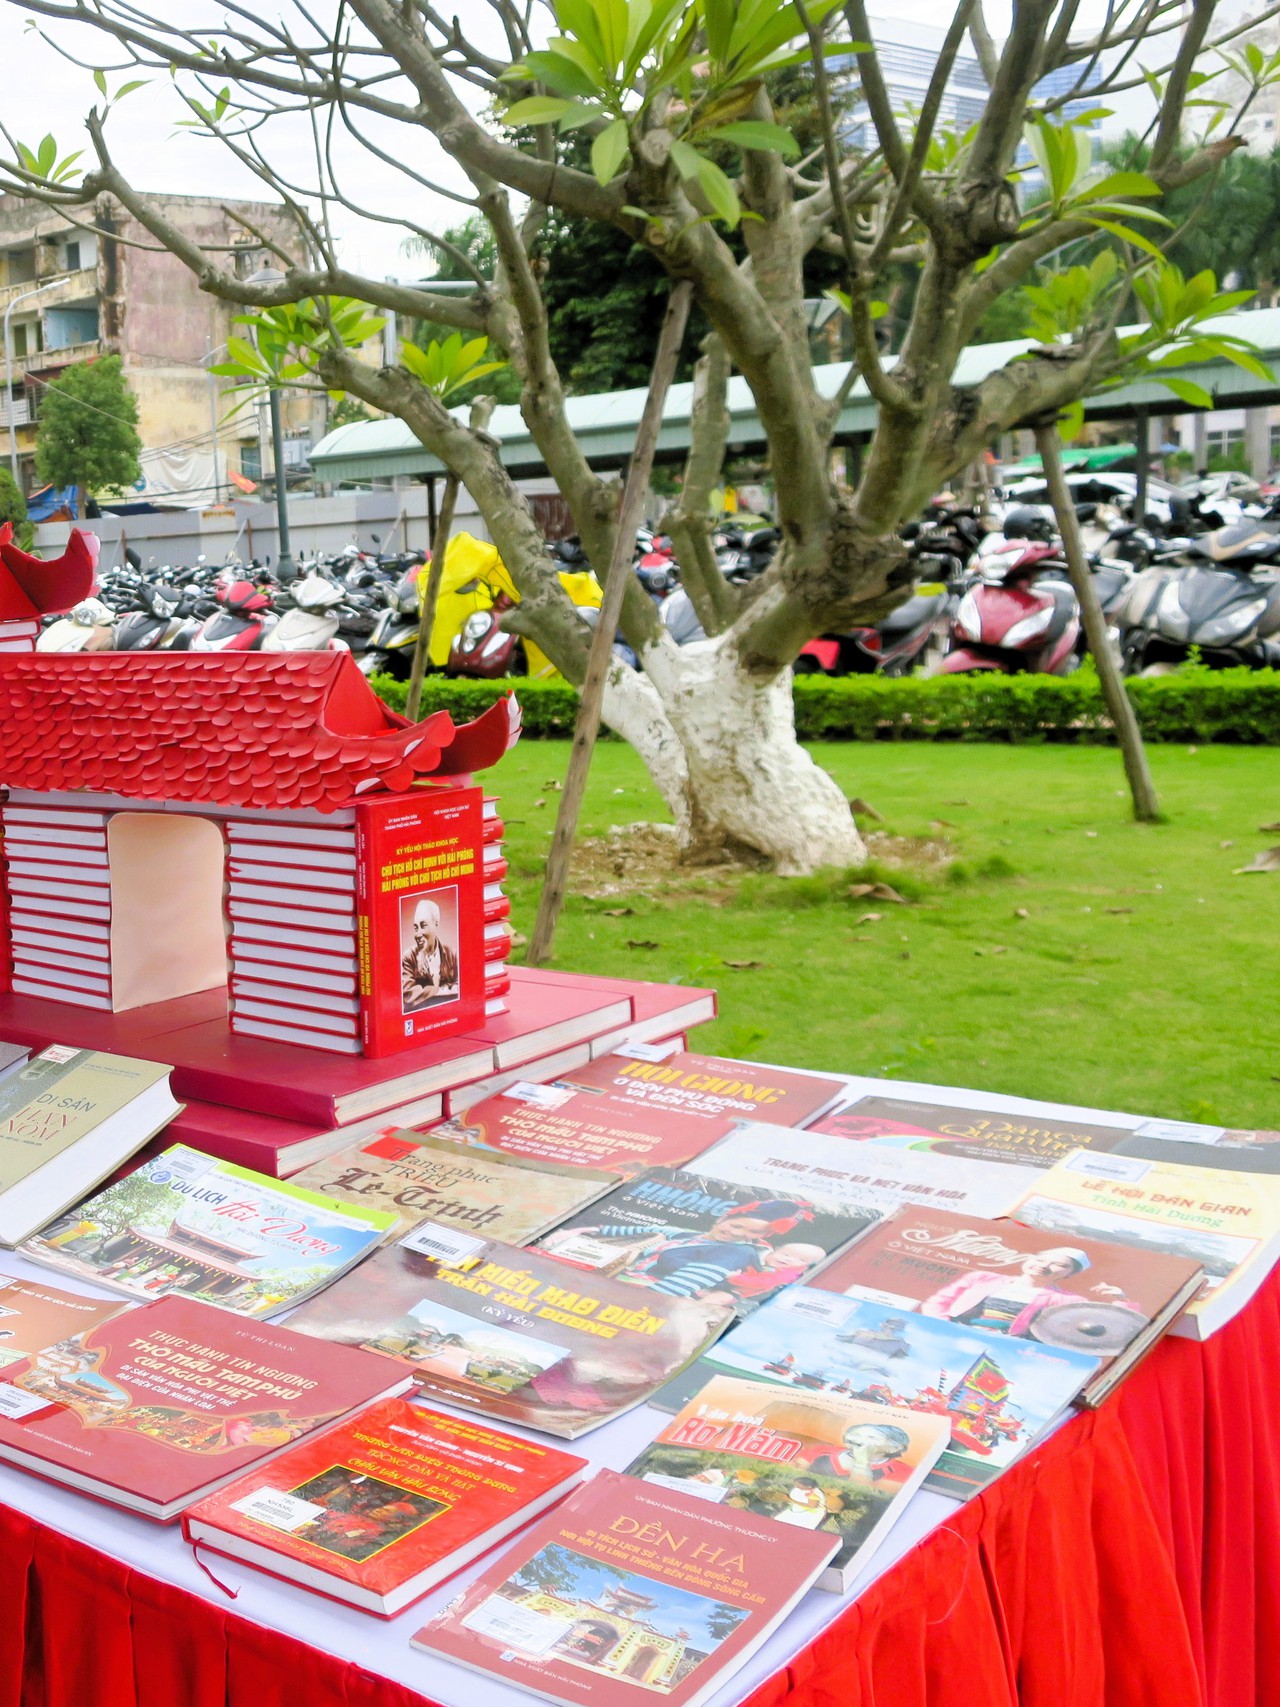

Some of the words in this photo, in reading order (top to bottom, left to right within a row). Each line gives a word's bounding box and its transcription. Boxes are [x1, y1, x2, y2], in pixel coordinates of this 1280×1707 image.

[36, 1093, 60, 1105] DI
[170, 1180, 193, 1194] DU
[192, 1188, 229, 1205] LỊCH
[185, 1343, 231, 1362] HÀNH
[134, 1355, 168, 1371] CỦA
[608, 1514, 690, 1553] ĐỀN
[690, 1541, 747, 1575] HẠ
